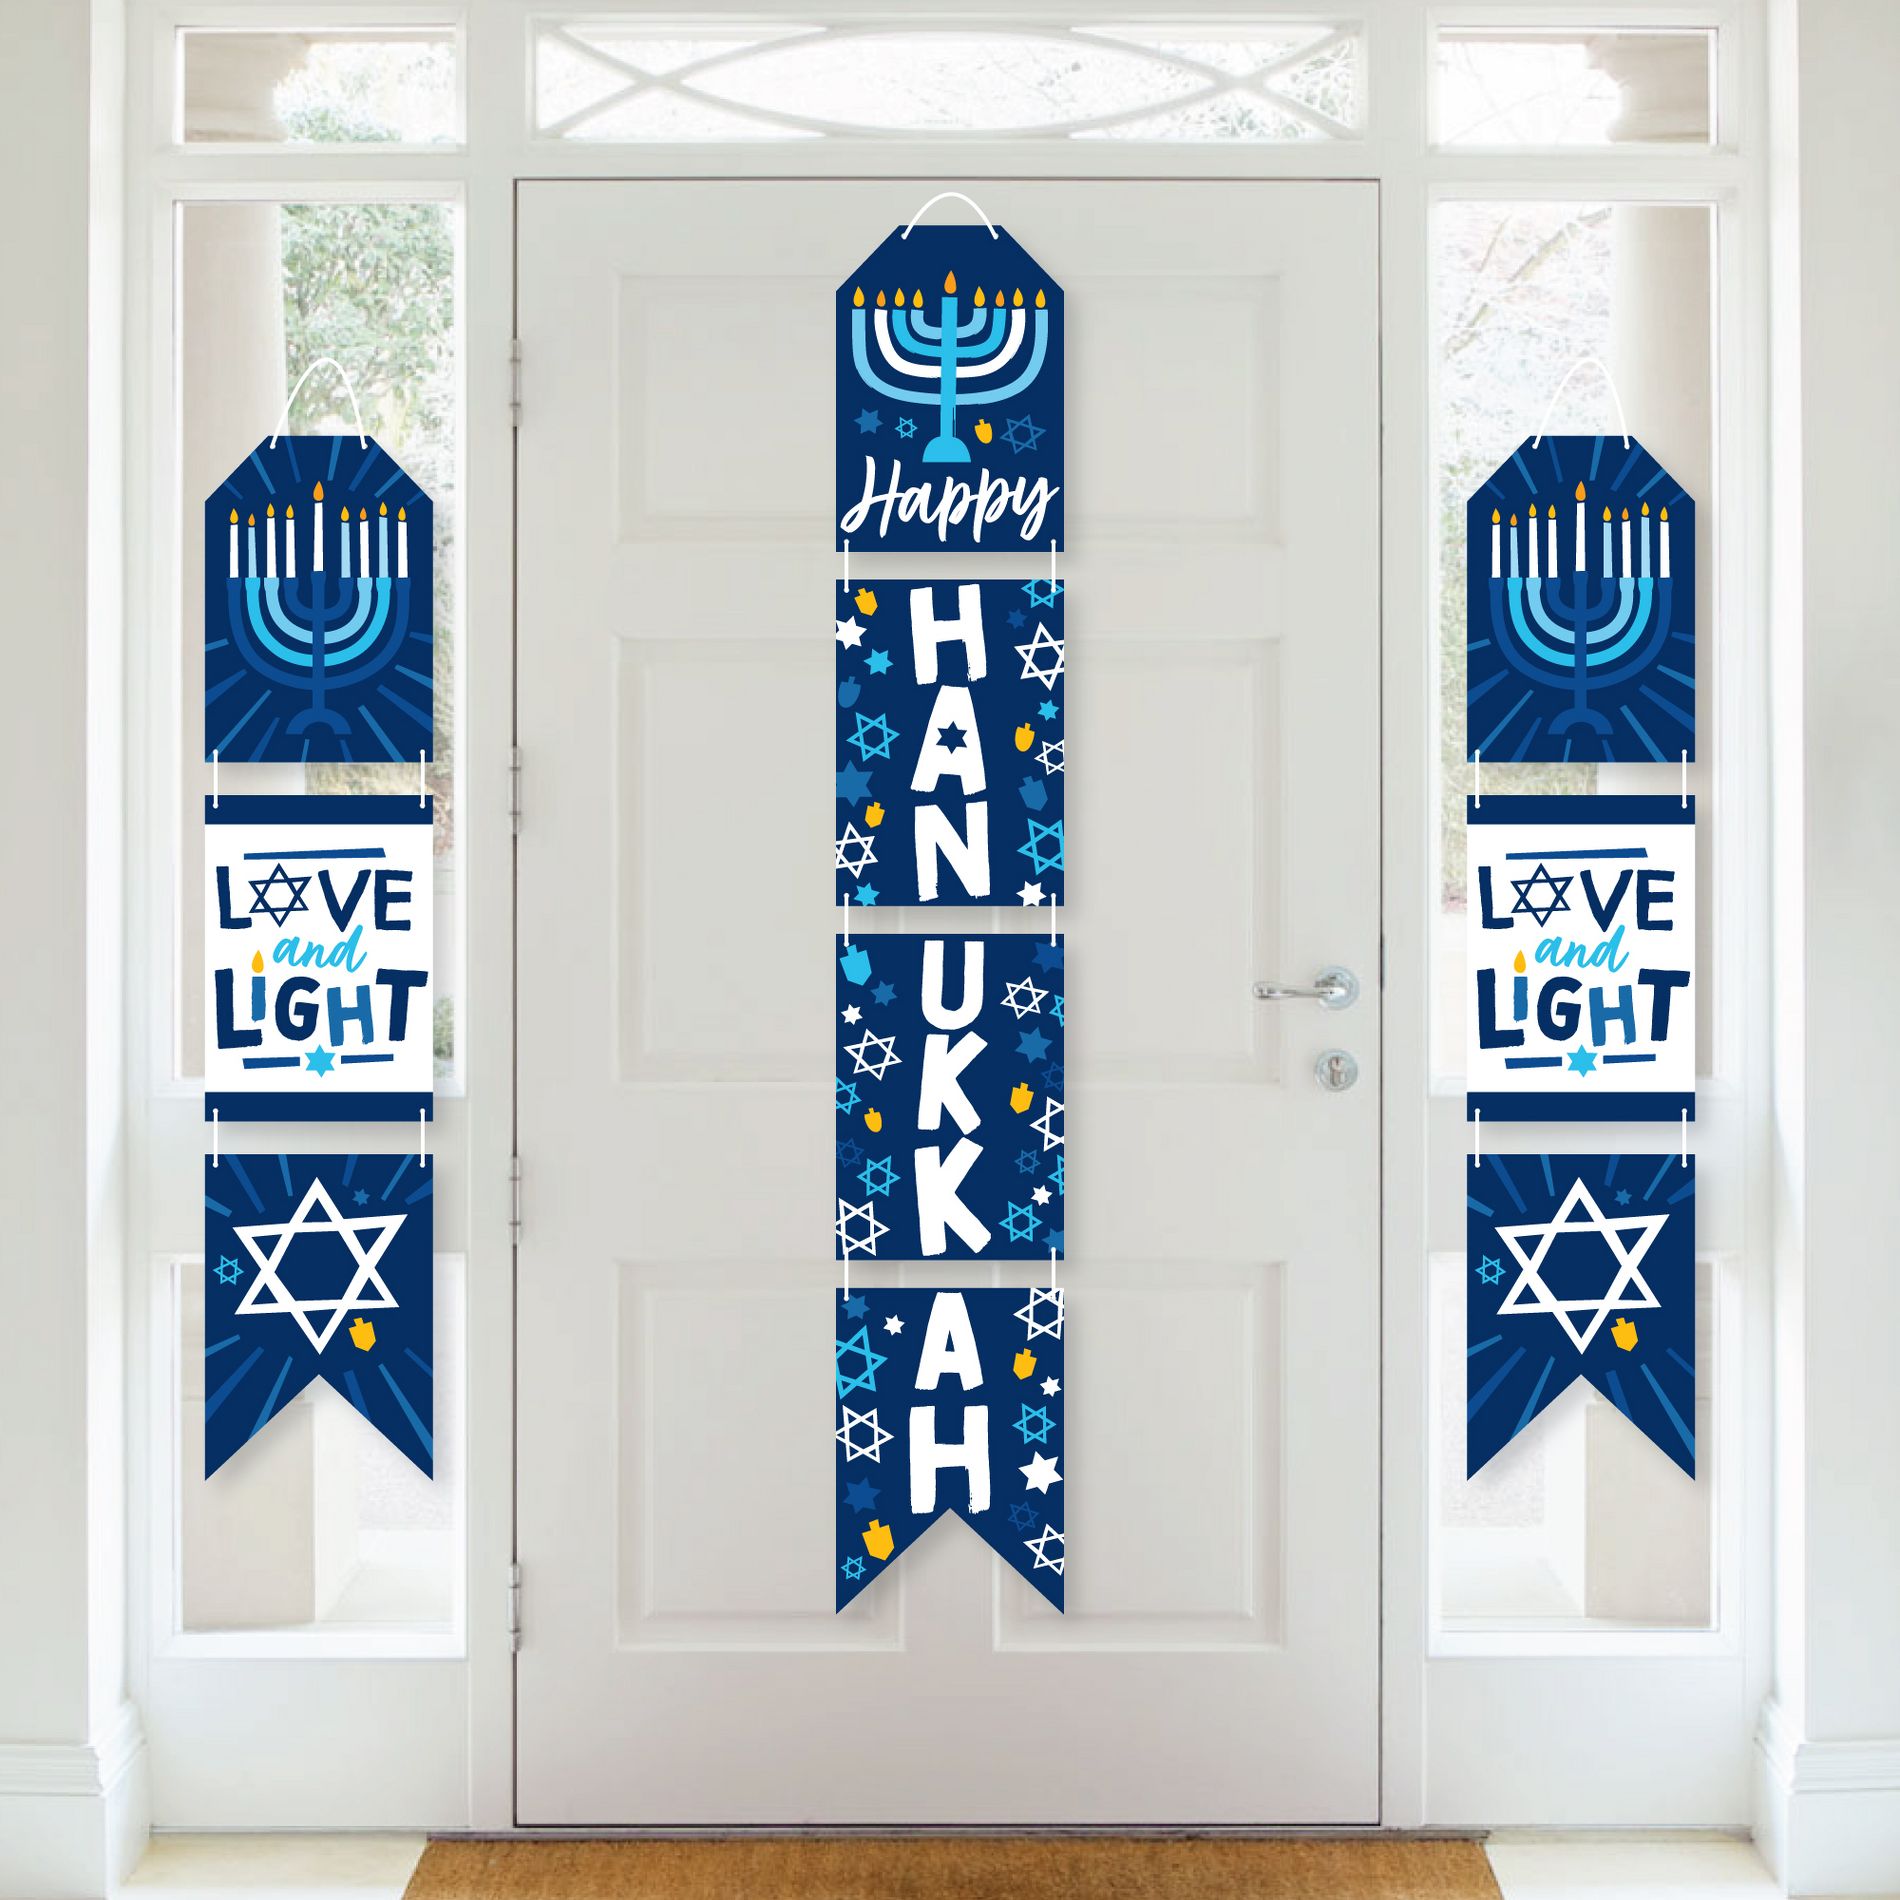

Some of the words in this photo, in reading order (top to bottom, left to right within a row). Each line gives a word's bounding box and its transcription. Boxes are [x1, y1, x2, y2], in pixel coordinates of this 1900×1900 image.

[840, 455, 1060, 543] Happy
[273, 924, 368, 973] and
[1535, 924, 1630, 973] and
